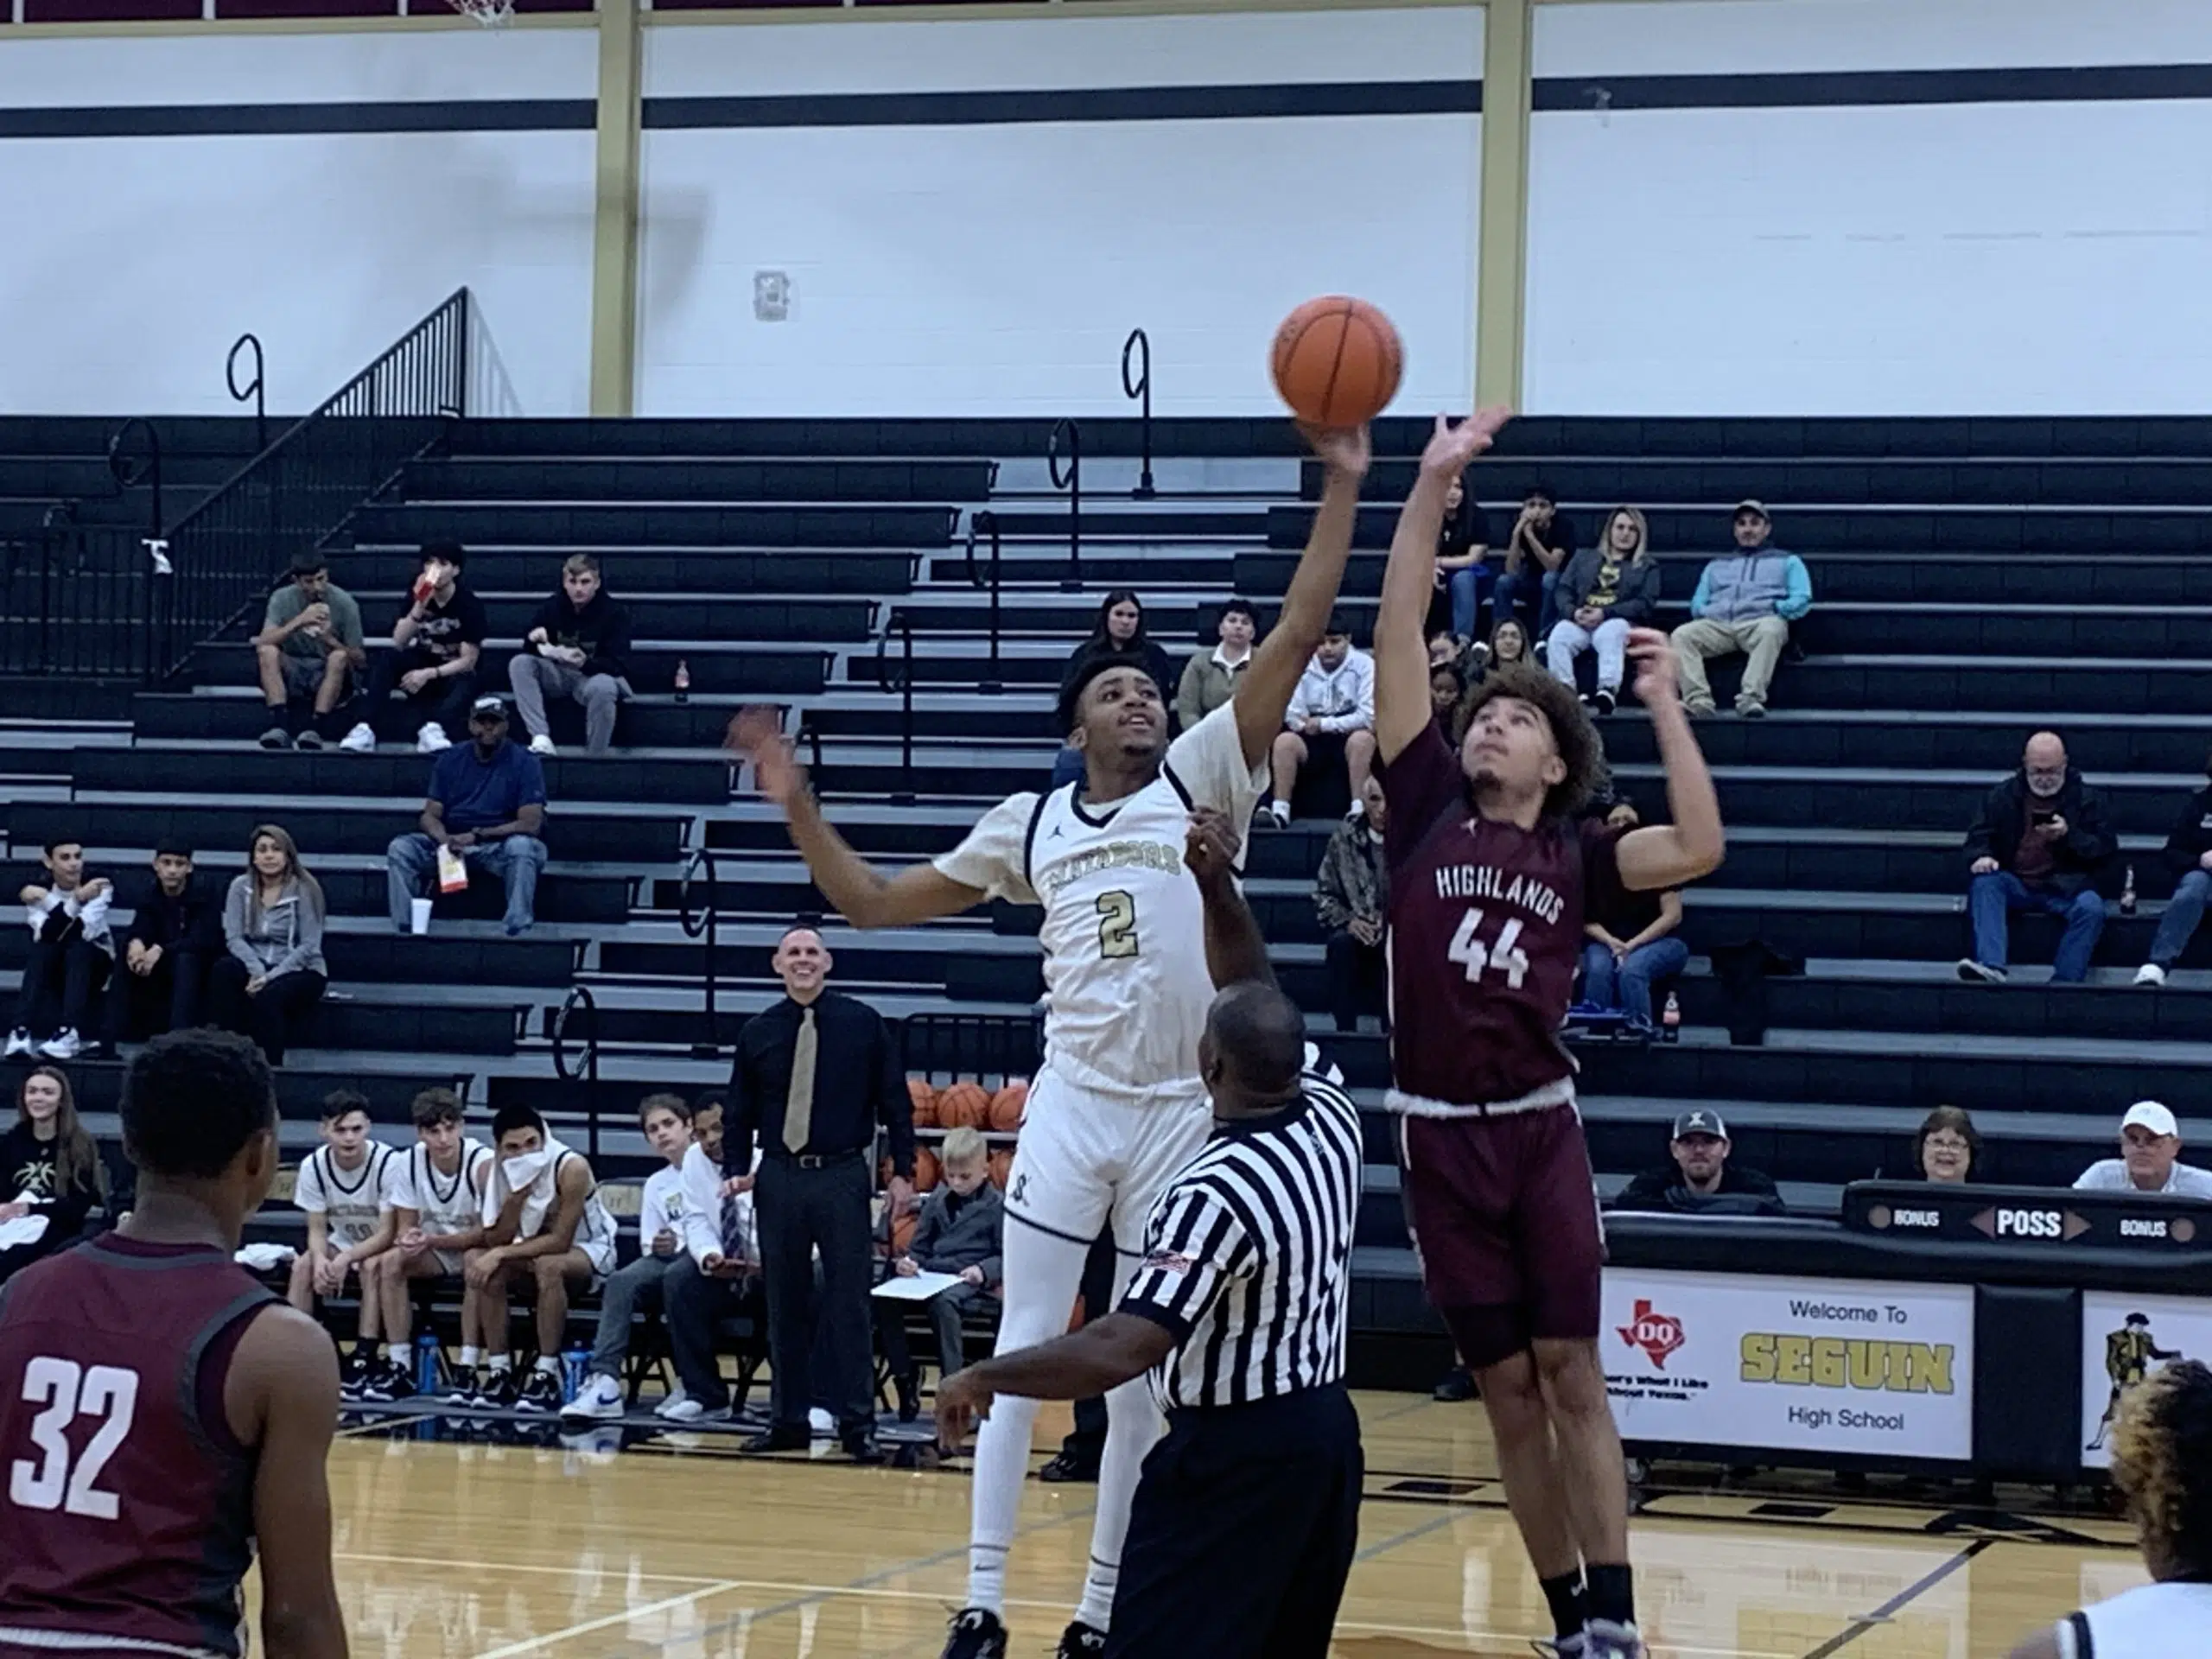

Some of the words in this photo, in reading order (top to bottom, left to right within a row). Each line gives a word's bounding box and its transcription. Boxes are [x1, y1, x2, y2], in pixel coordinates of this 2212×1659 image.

[1434, 863, 1565, 926] HIGHLANDS
[1094, 889, 1139, 959] 2
[1446, 906, 1530, 990] 44
[1893, 1209, 1940, 1228] BONUS
[1997, 1208, 2063, 1238] POSS
[2120, 1218, 2167, 1238] BONUS
[1789, 1300, 1878, 1324] Welcome
[1885, 1305, 1908, 1325] To
[1739, 1332, 1955, 1396] SEGUIN
[9, 1355, 140, 1522] 32
[1788, 1406, 1832, 1430] High
[1837, 1408, 1905, 1432] School
